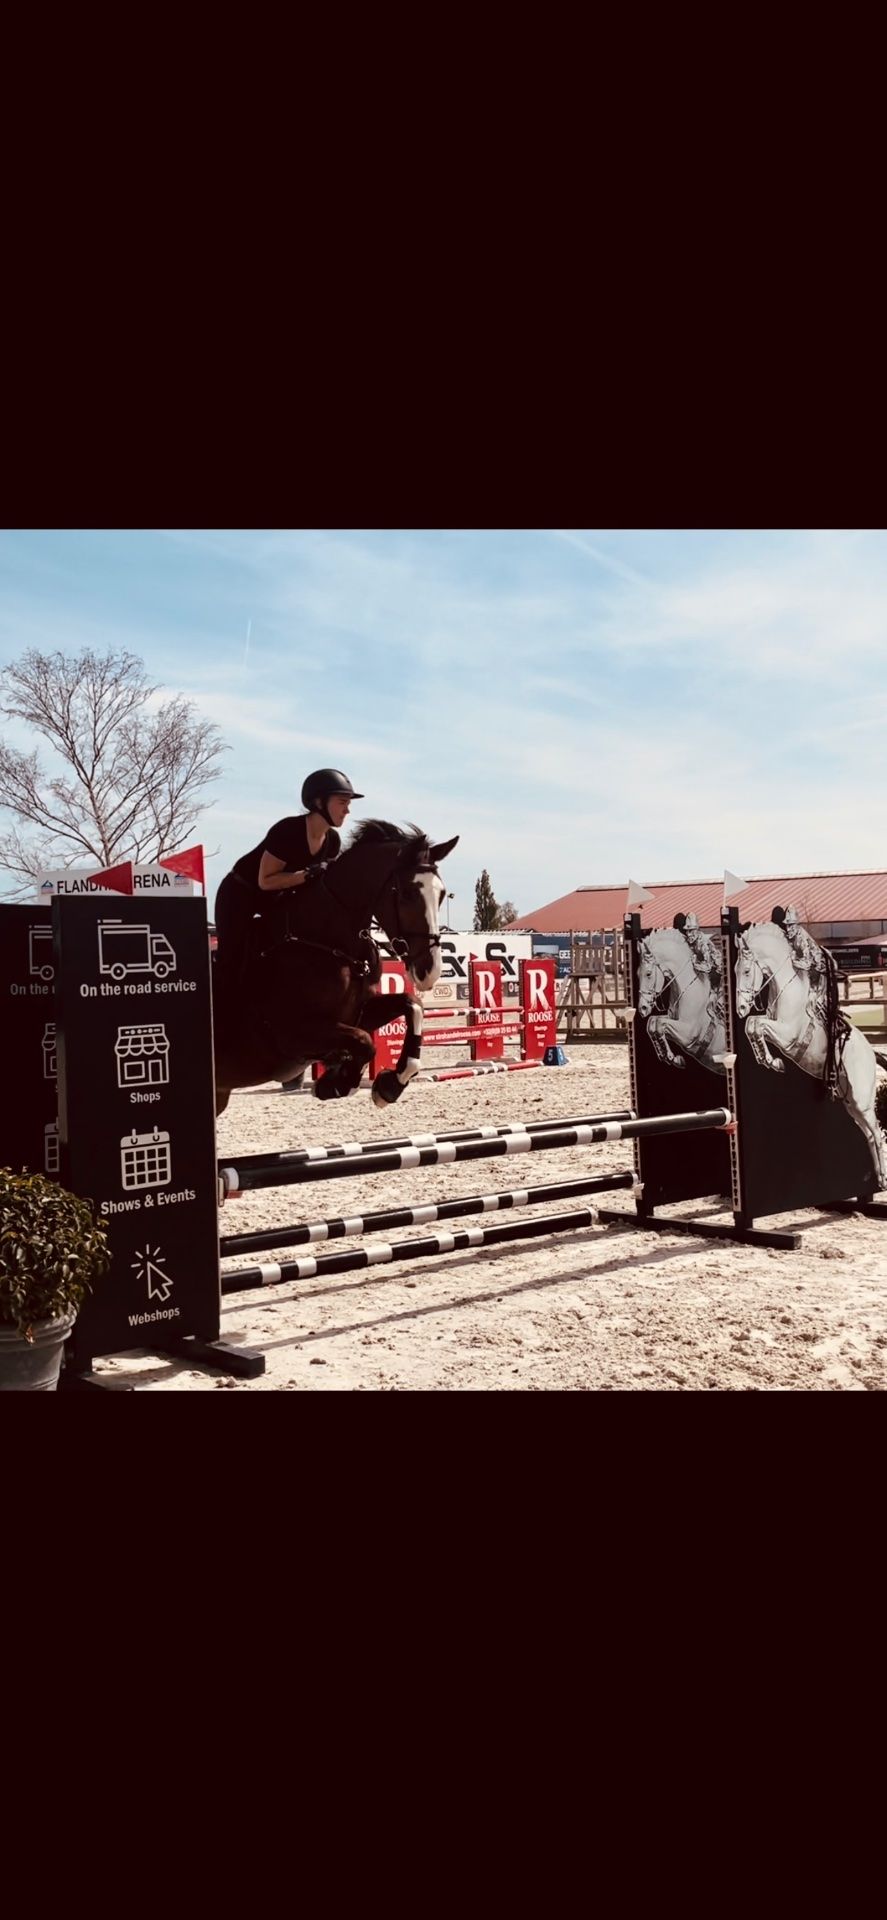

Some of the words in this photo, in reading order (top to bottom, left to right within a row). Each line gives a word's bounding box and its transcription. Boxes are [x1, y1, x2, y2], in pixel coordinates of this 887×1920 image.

[57, 878, 113, 894] FLAND
[133, 873, 171, 889] RENA
[10, 983, 27, 995] On
[30, 983, 49, 995] the
[80, 983, 97, 997] On
[101, 982, 120, 996] the
[124, 981, 151, 995] road
[155, 979, 196, 993] service
[526, 969, 552, 1011] R
[477, 1013, 501, 1024] ROOSE
[528, 1010, 553, 1023] ROOSE
[378, 1022, 408, 1037] ROOS
[547, 1049, 553, 1062] 5
[130, 1091, 161, 1104] Shops
[100, 1198, 141, 1215] Shows
[144, 1194, 155, 1208] &
[157, 1188, 196, 1206] Events
[128, 1306, 180, 1327] Webshops
